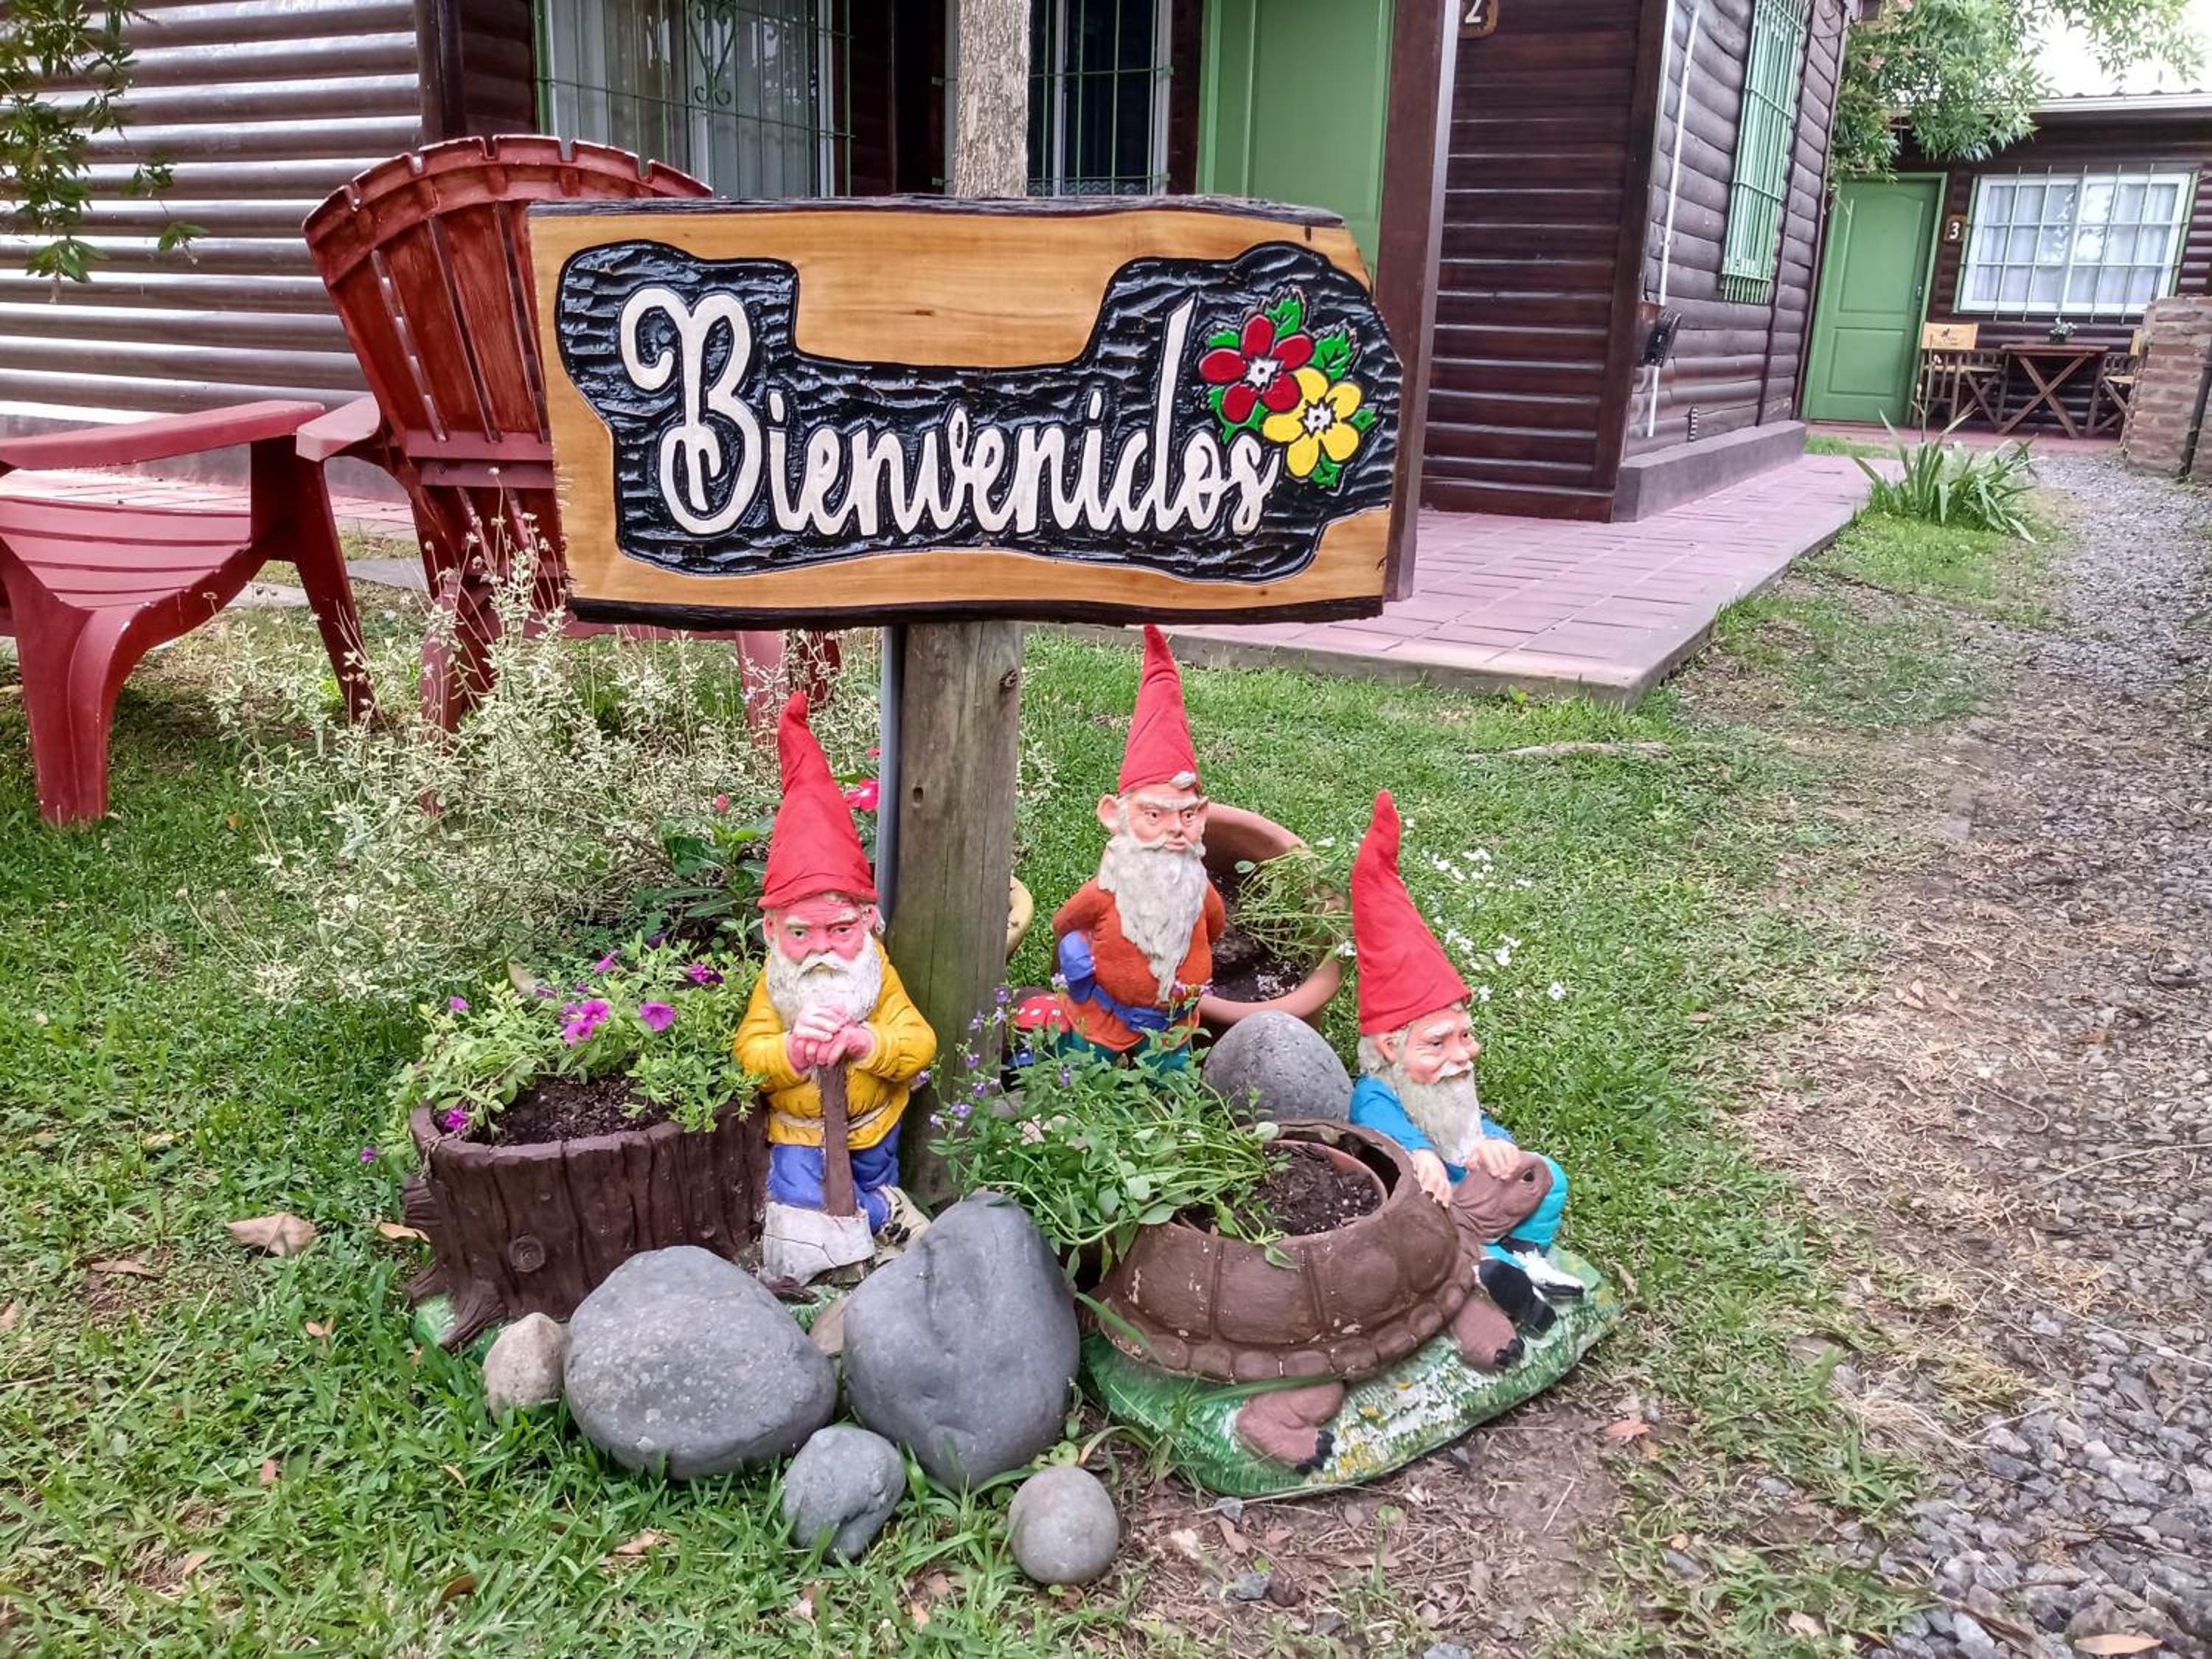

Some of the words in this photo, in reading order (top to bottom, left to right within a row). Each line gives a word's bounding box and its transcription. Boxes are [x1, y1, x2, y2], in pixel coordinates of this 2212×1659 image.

[1465, 0, 1482, 24] 2
[1950, 222, 1960, 240] 3
[619, 288, 1280, 537] Bienvenidos
